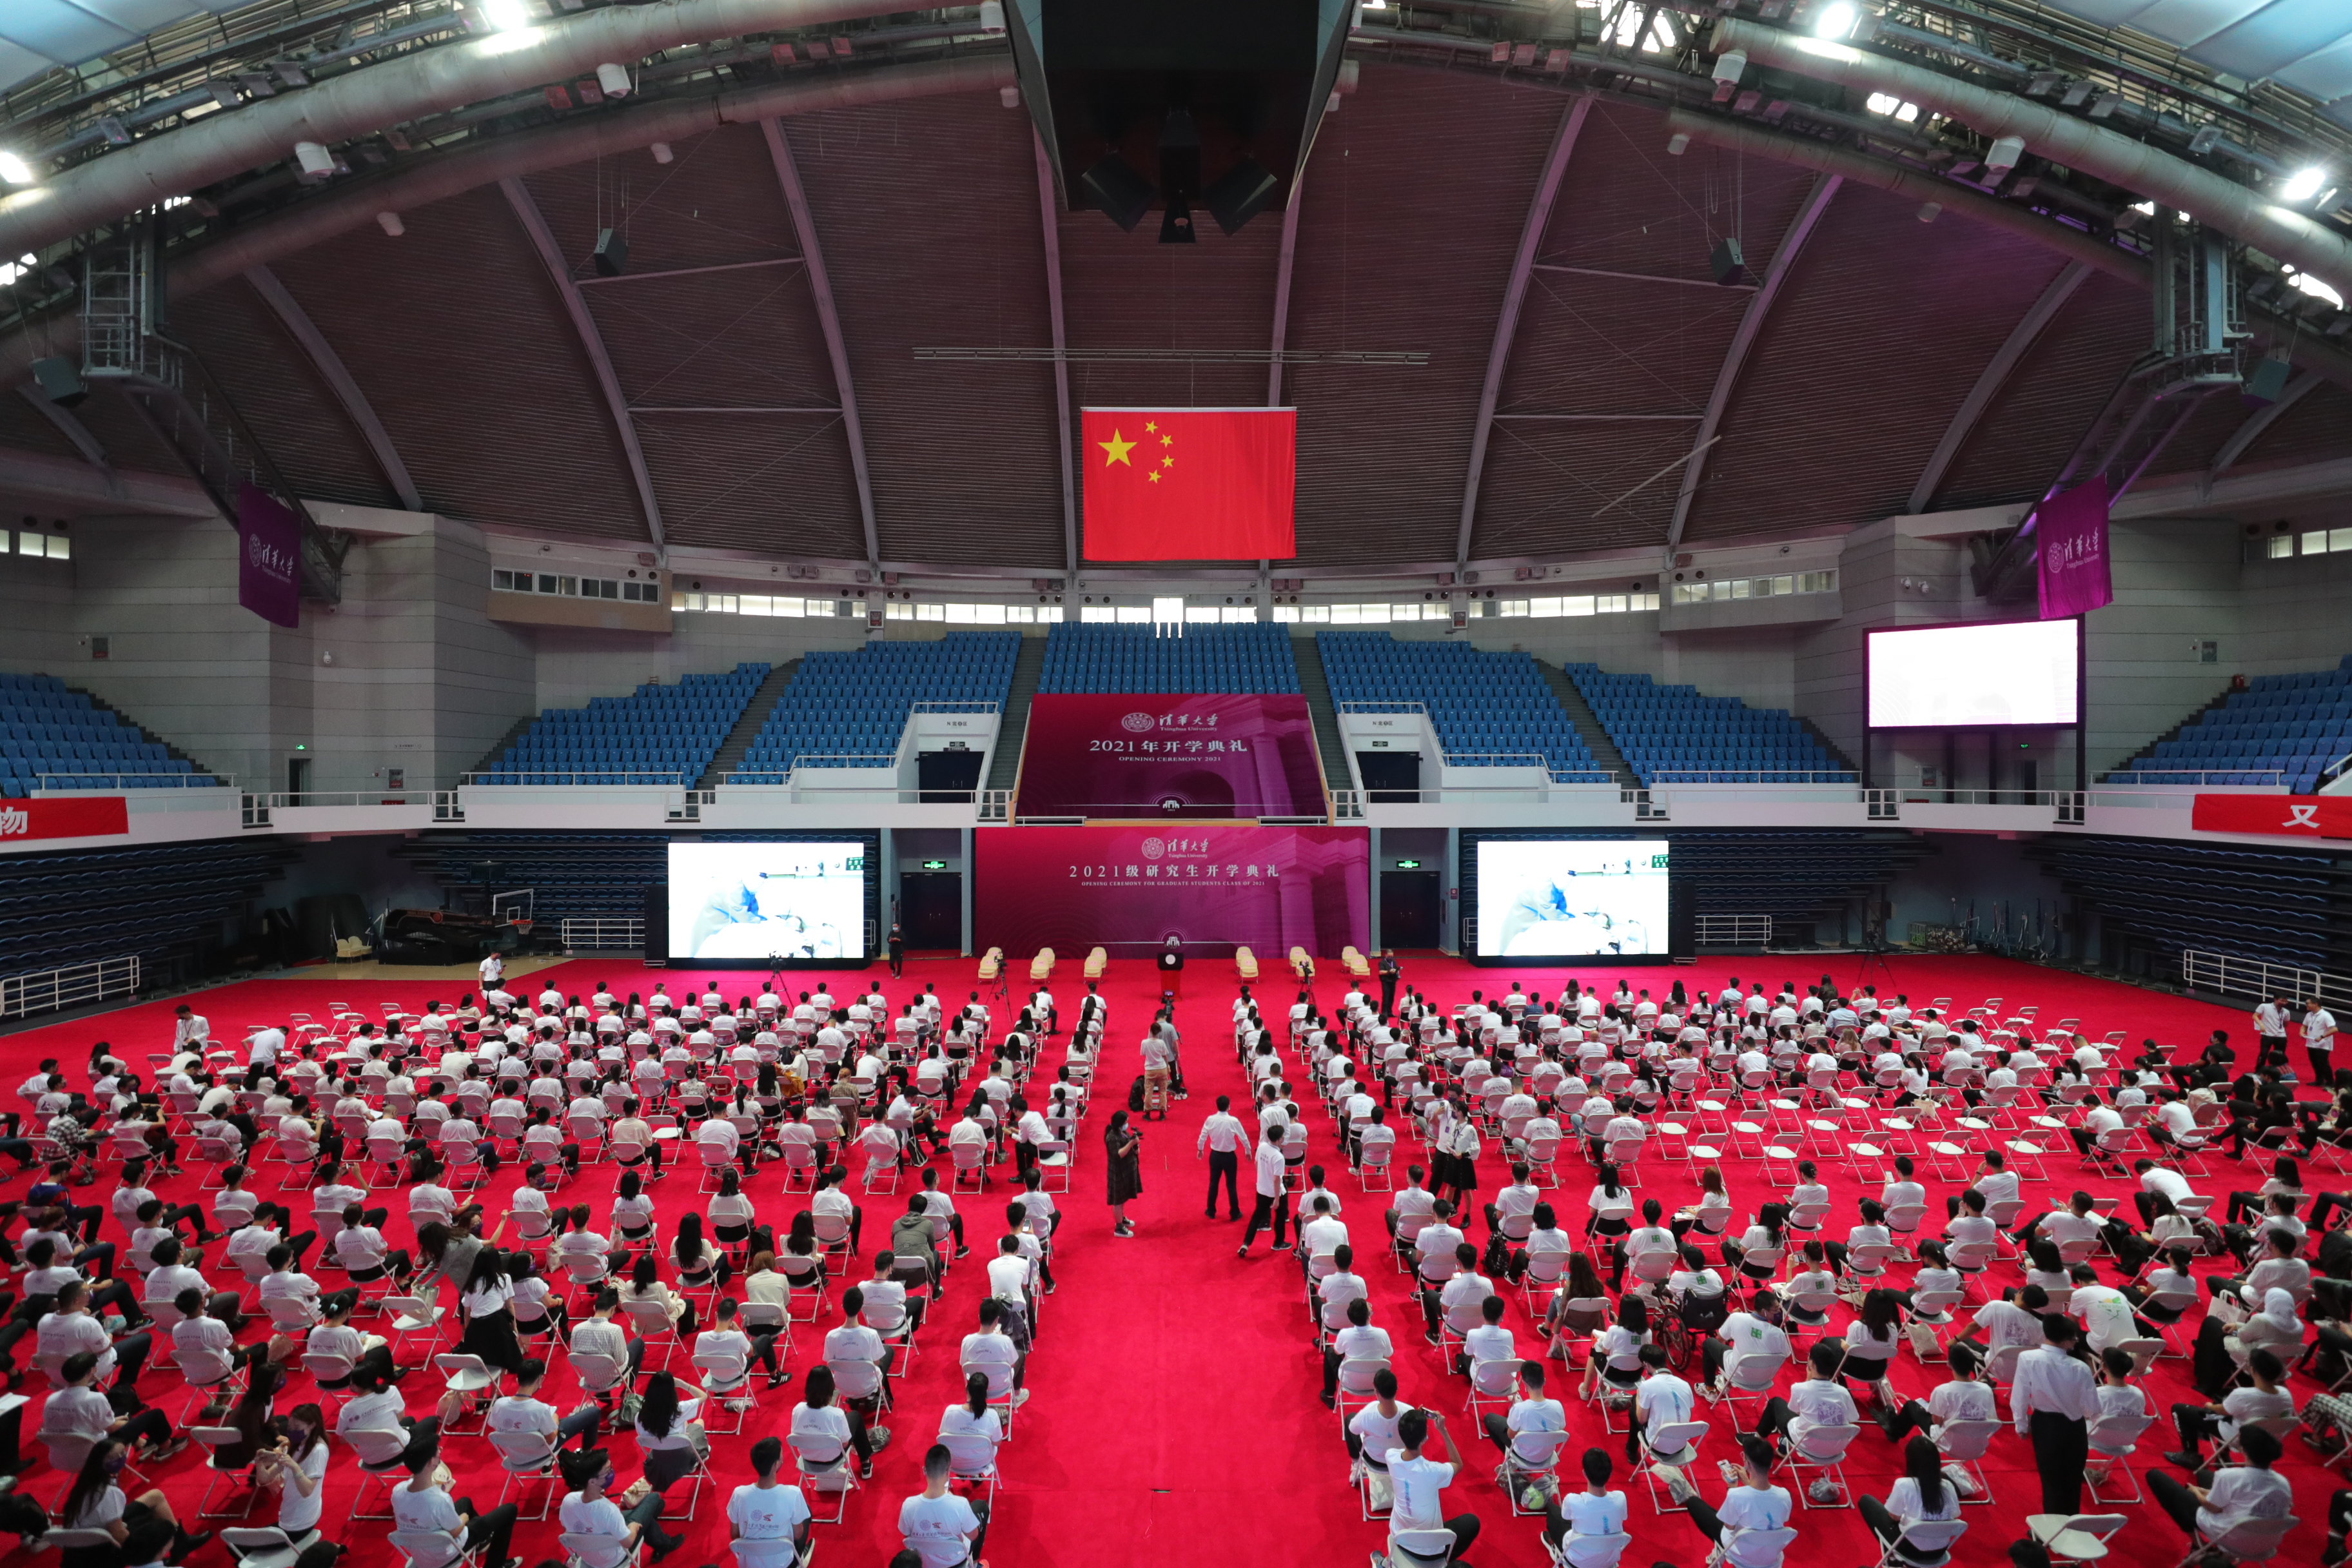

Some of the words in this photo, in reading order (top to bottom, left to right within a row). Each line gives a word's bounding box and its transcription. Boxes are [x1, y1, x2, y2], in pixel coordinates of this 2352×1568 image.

[1090, 740, 1248, 752] 2021年开学典礼
[1069, 864, 1279, 877] 2021级研究生开学典礼
